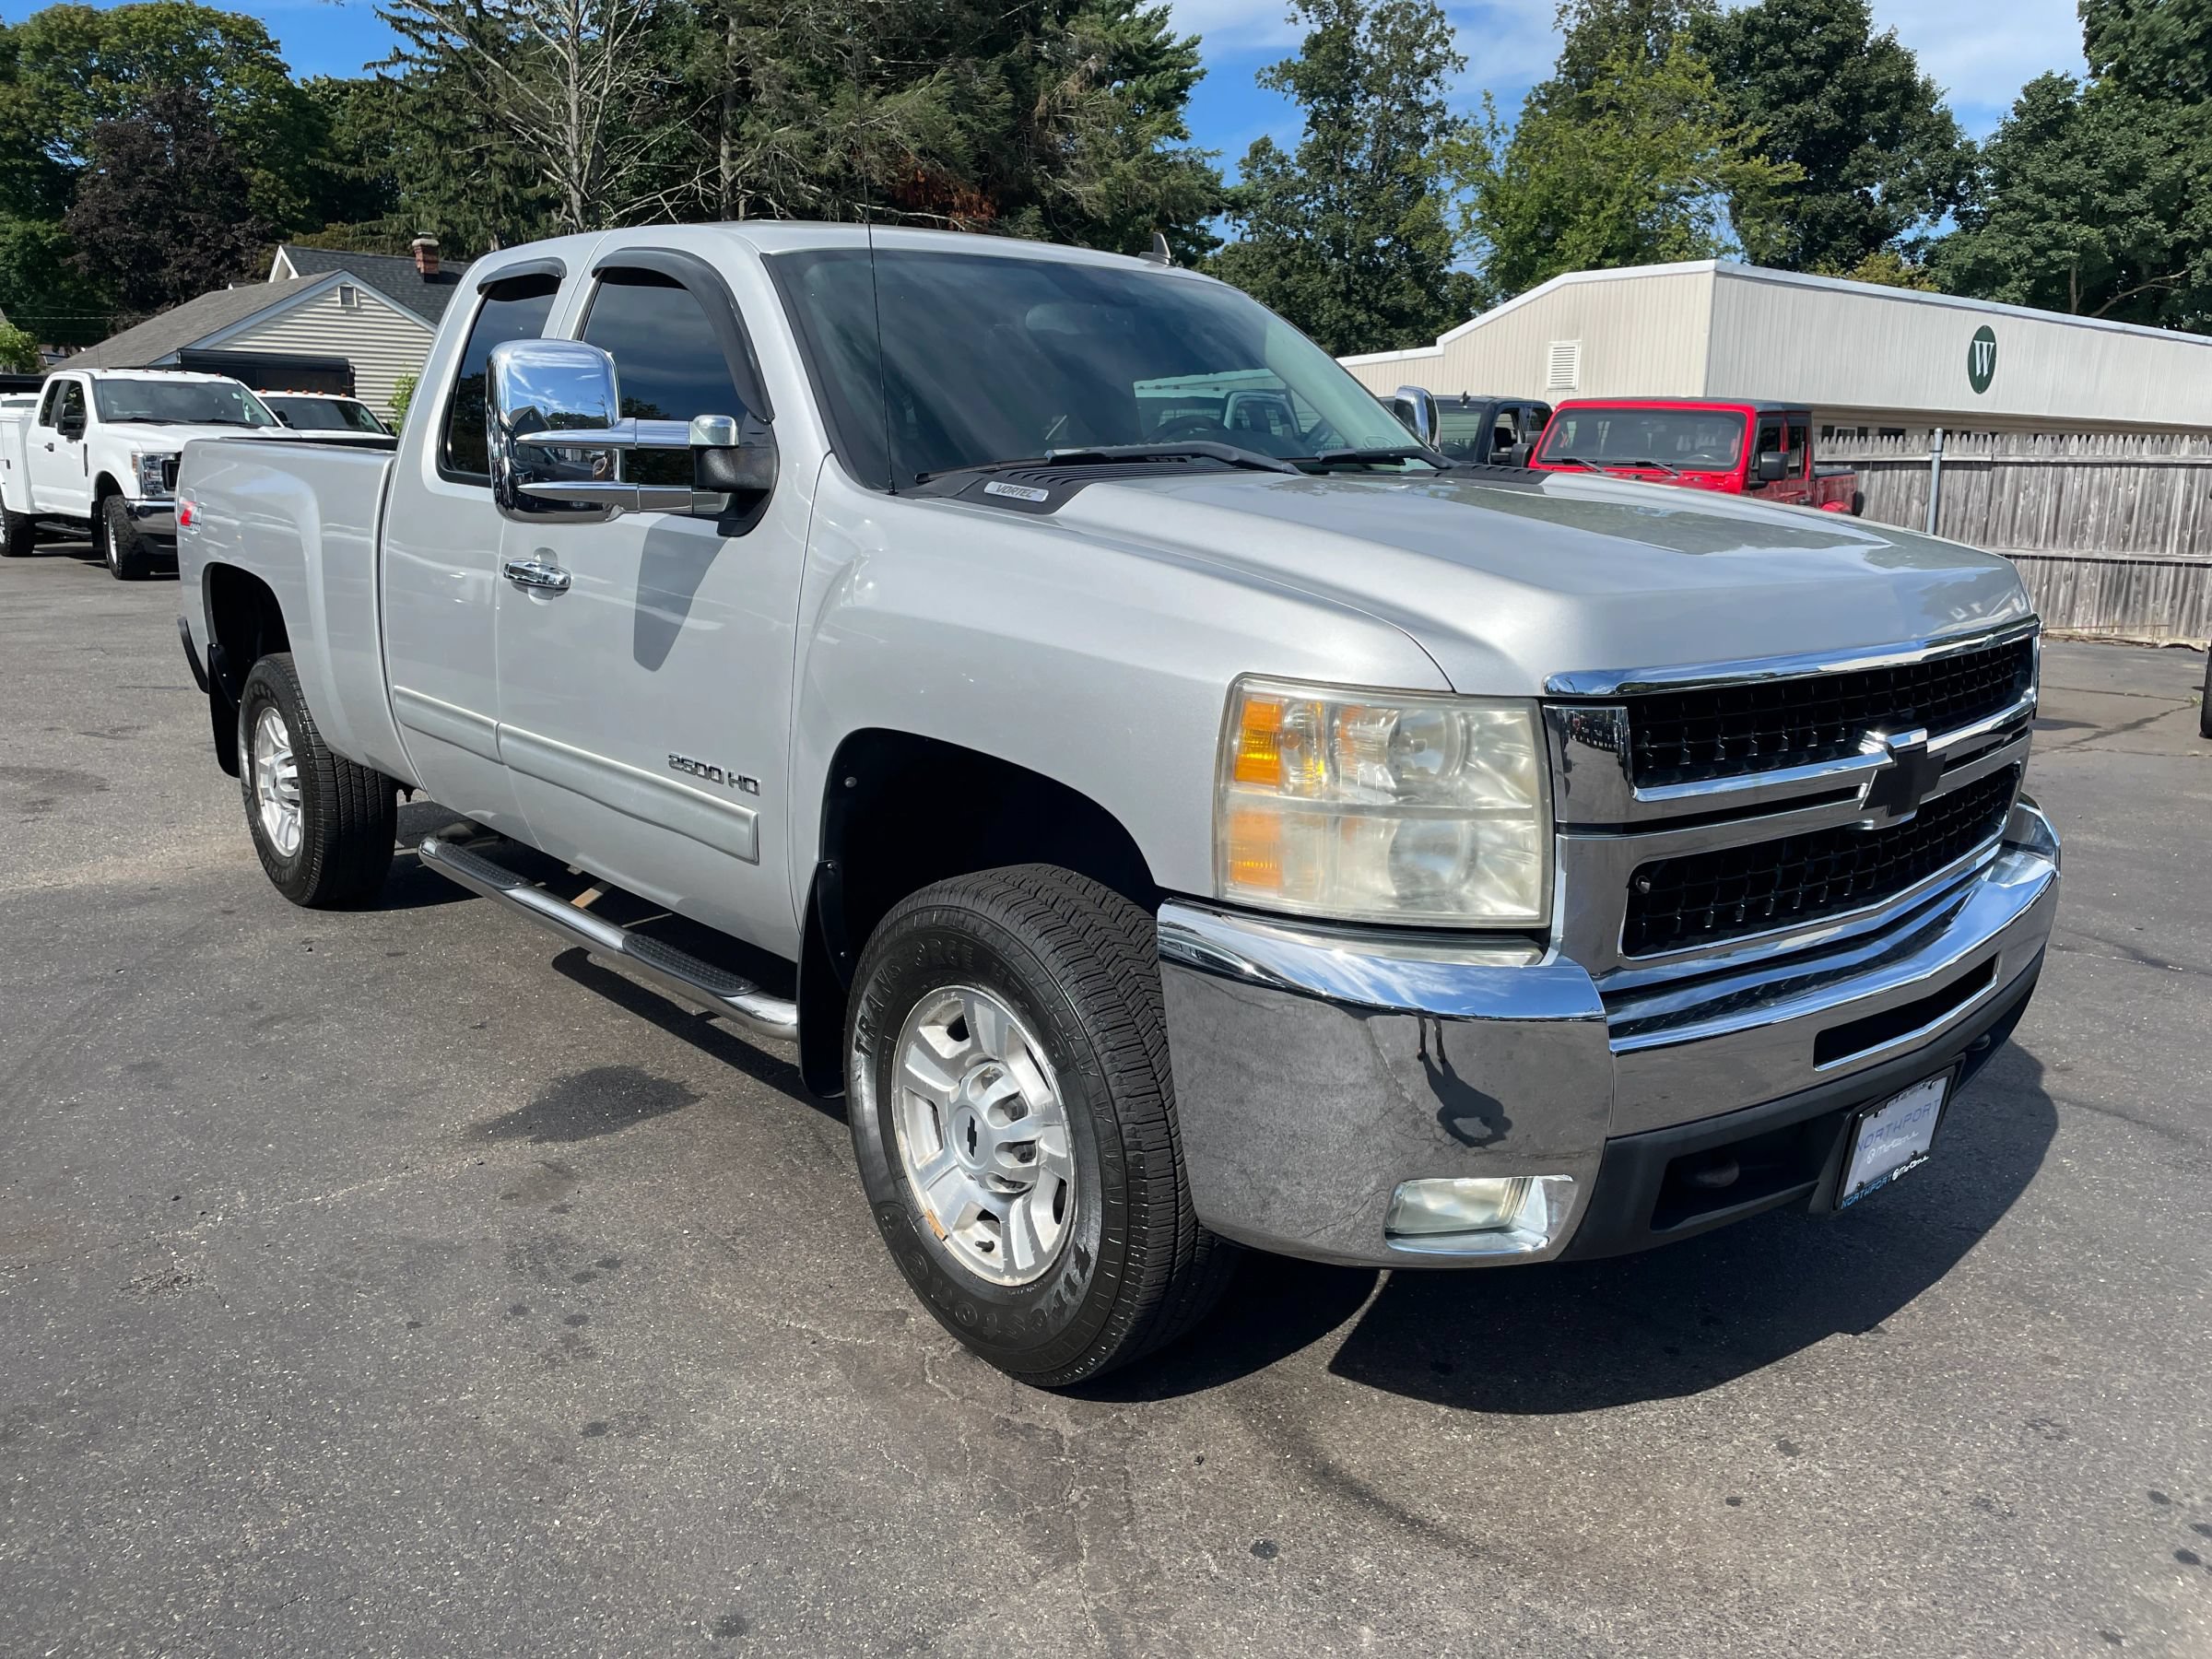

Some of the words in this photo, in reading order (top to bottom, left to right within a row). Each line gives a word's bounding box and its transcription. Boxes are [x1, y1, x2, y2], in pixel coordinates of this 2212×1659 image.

[1973, 339, 1995, 377] W
[995, 484, 1039, 498] VORTEC
[668, 752, 724, 785] 2500
[727, 771, 761, 796] HD
[854, 937, 974, 1059] TRANSORCE
[1857, 1099, 1940, 1152] NORTHPORT
[1842, 1174, 1893, 1207] NORTHPORT
